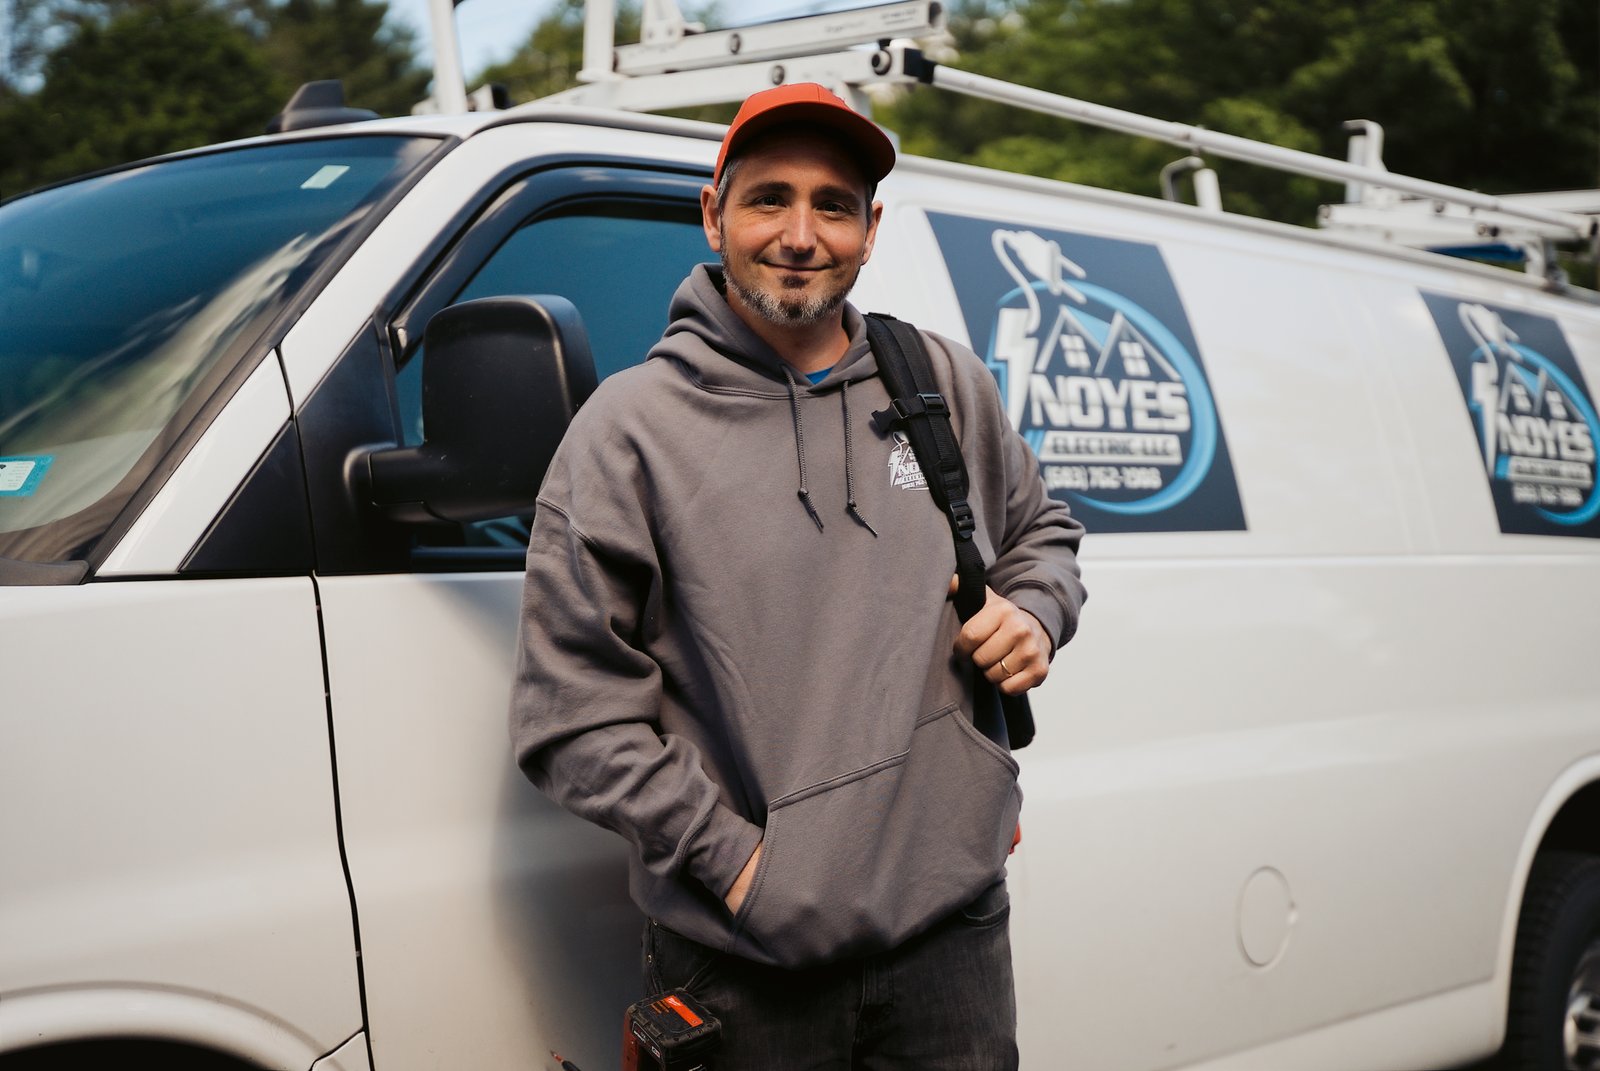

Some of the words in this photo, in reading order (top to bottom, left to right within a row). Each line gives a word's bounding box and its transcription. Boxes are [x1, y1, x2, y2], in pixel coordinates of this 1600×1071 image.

[1030, 373, 1191, 432] NOYES
[1052, 437, 1135, 456] ELECTRIC
[1142, 438, 1174, 458] LLC
[1497, 412, 1595, 463] NOYES
